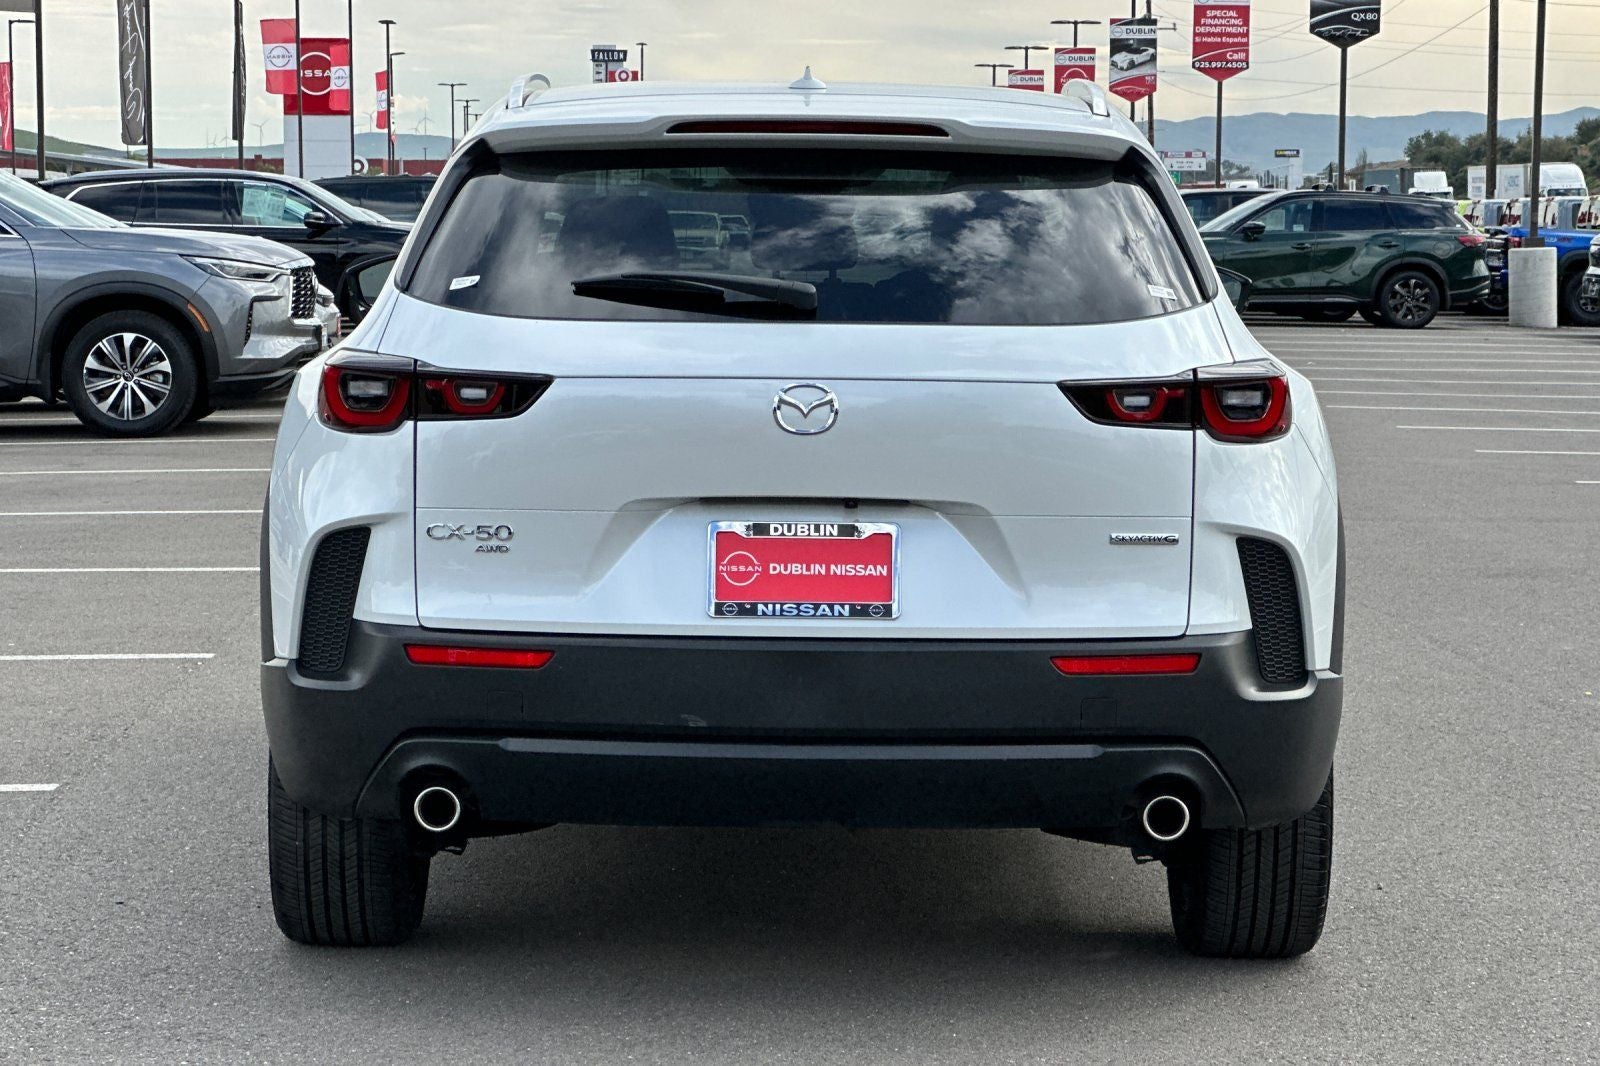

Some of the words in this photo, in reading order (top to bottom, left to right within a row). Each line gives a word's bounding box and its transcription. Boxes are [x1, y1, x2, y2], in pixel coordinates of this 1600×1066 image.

[1351, 12, 1378, 21] QX80
[1201, 18, 1243, 26] FINANCING
[1195, 26, 1248, 34] DEPARTMENT
[594, 51, 624, 60] FALLON
[1226, 52, 1246, 60] Call!
[1194, 61, 1248, 69] 925.997.4505
[301, 69, 331, 77] ISSA
[426, 523, 514, 541] CX-50
[769, 523, 839, 536] DUBLIN
[475, 544, 510, 554] AWD
[768, 563, 826, 575] DUBLIN
[830, 564, 888, 577] NISSAN
[757, 603, 850, 616] NISSAN
